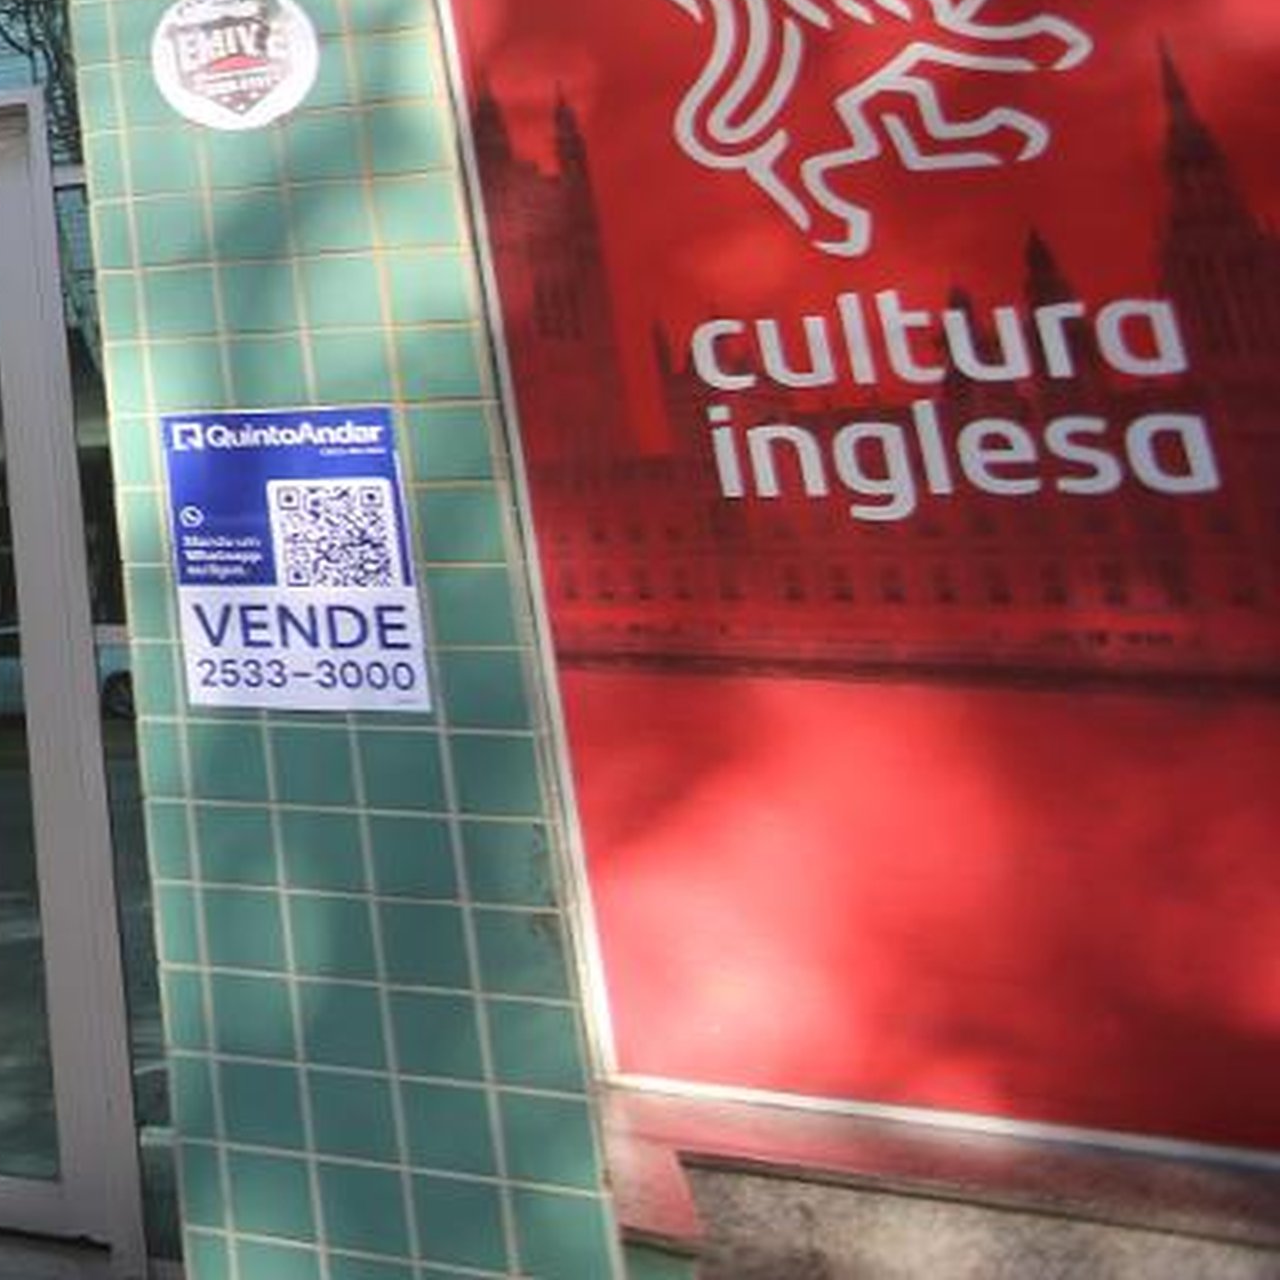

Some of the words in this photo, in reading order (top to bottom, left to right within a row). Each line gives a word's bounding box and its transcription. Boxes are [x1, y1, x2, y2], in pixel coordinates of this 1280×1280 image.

[692, 291, 1190, 391] cultura
[206, 420, 384, 449] QuintoAndar
[708, 400, 1221, 521] inglesa
[192, 603, 413, 650] VENDE
[197, 659, 416, 691] 2533-3000
